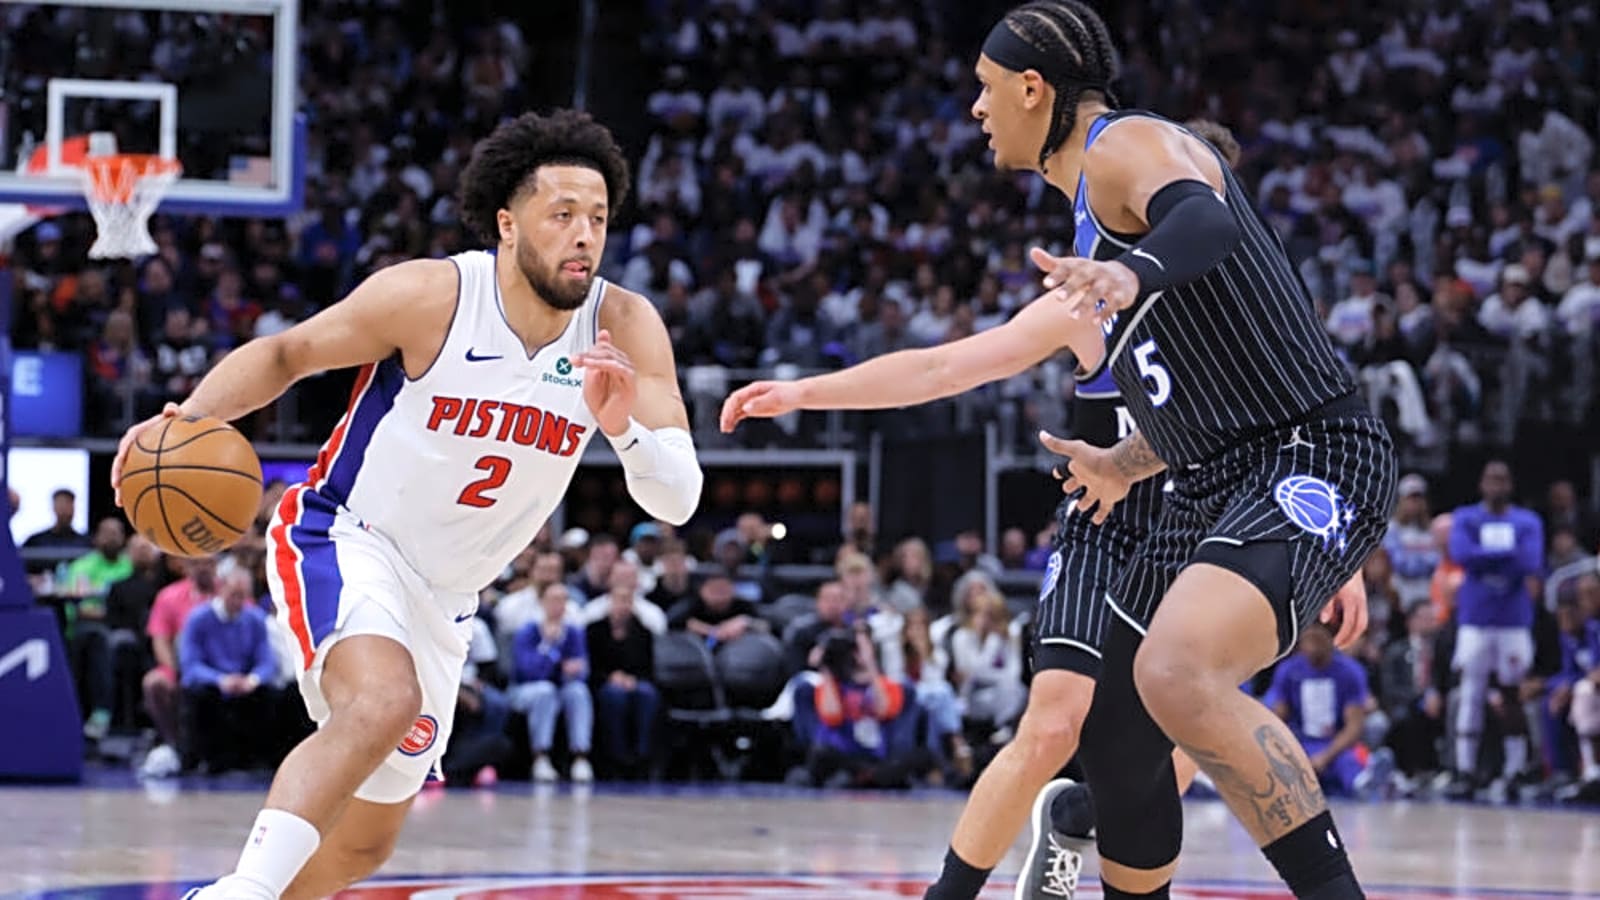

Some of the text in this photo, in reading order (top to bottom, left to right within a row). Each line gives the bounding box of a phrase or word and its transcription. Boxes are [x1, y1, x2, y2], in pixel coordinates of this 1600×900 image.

[1133, 338, 1171, 407] 5
[427, 396, 586, 457] PISTONS
[456, 455, 512, 508] 2
